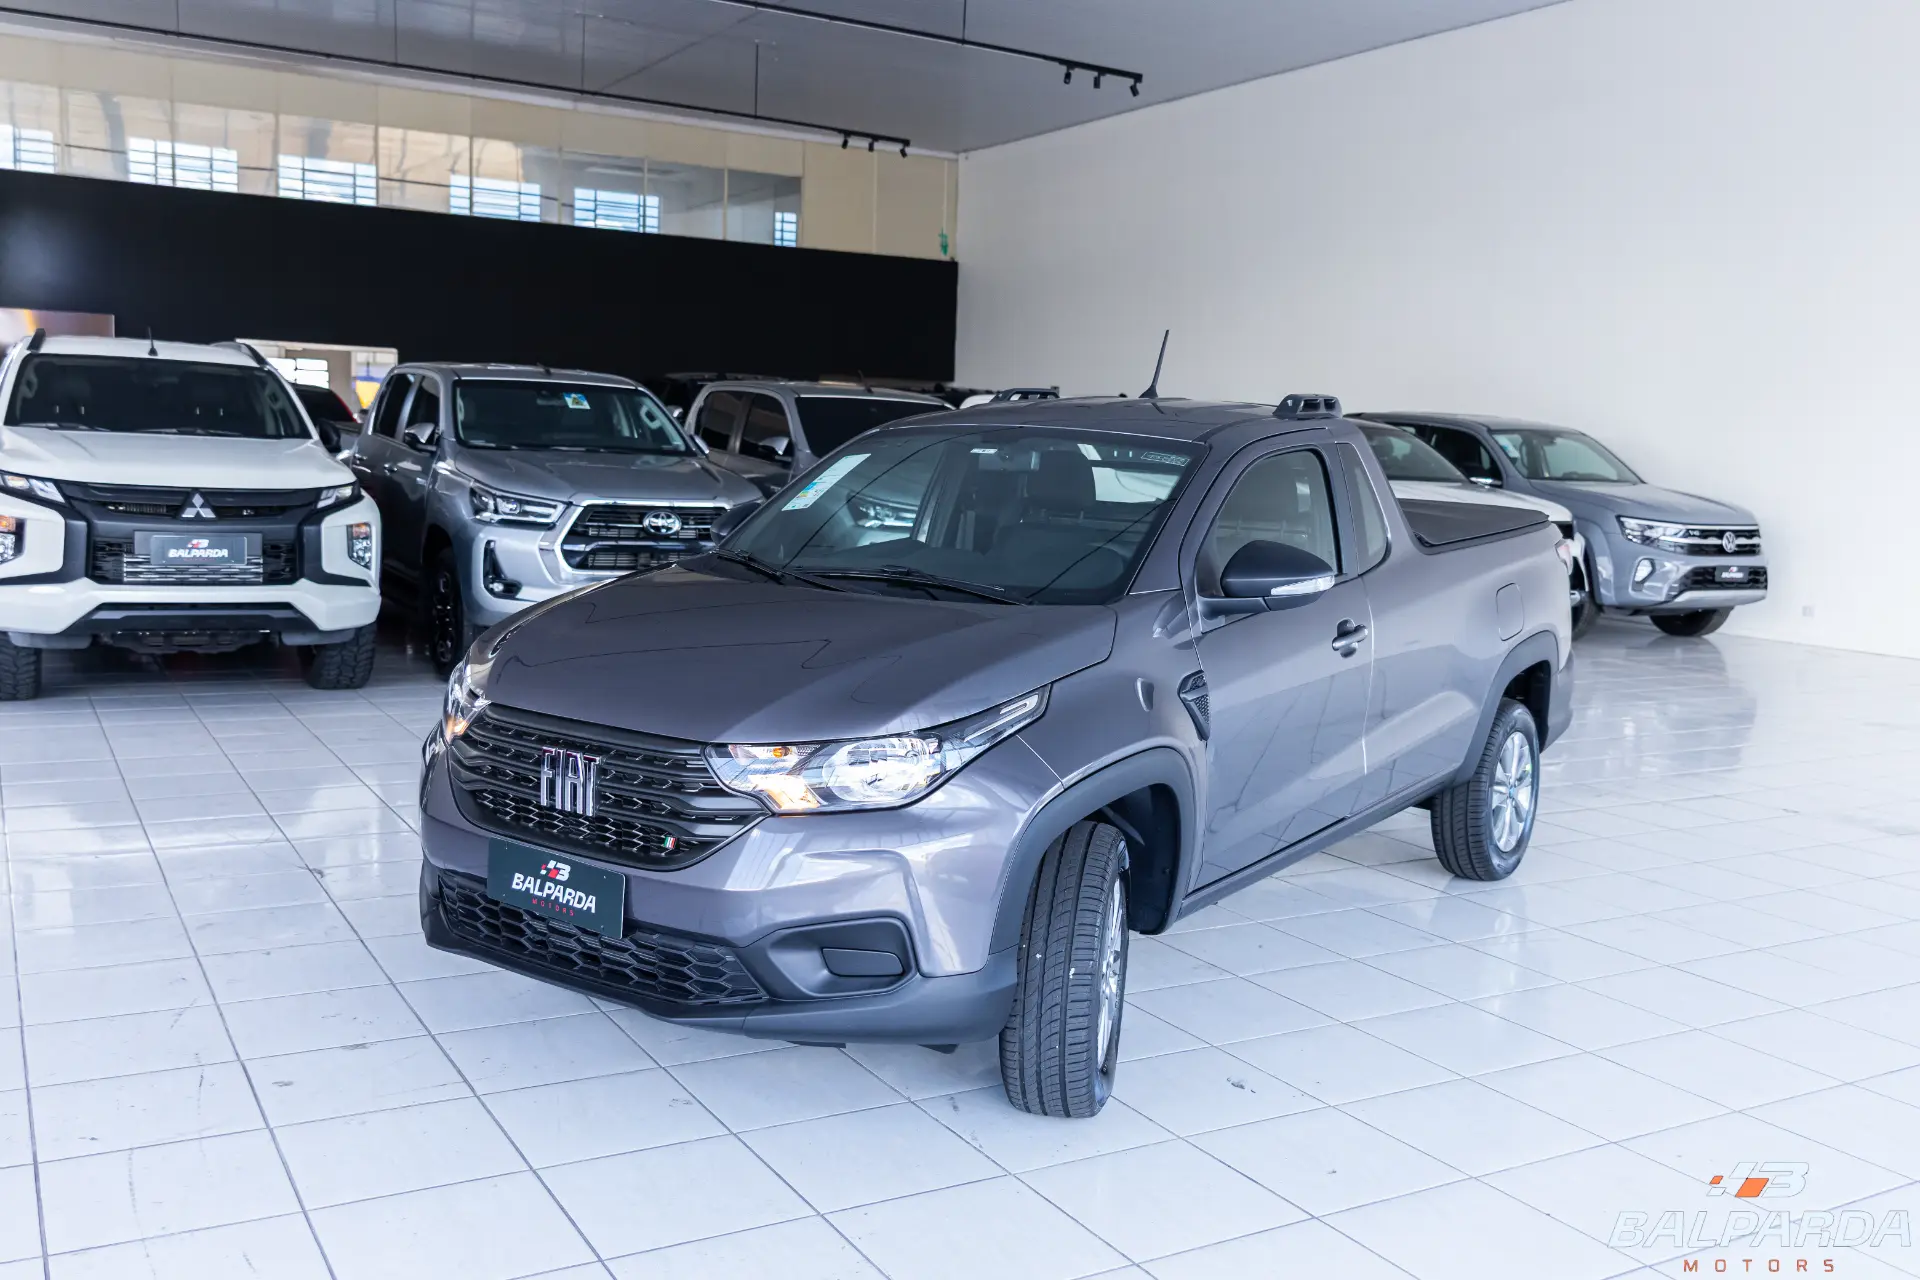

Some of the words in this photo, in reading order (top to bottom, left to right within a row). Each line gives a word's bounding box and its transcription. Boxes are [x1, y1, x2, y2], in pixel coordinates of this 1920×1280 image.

[167, 548, 229, 558] BALPARDA
[540, 746, 601, 817] FIAT
[511, 872, 597, 914] BALPARDA
[532, 898, 575, 917] MOTORS
